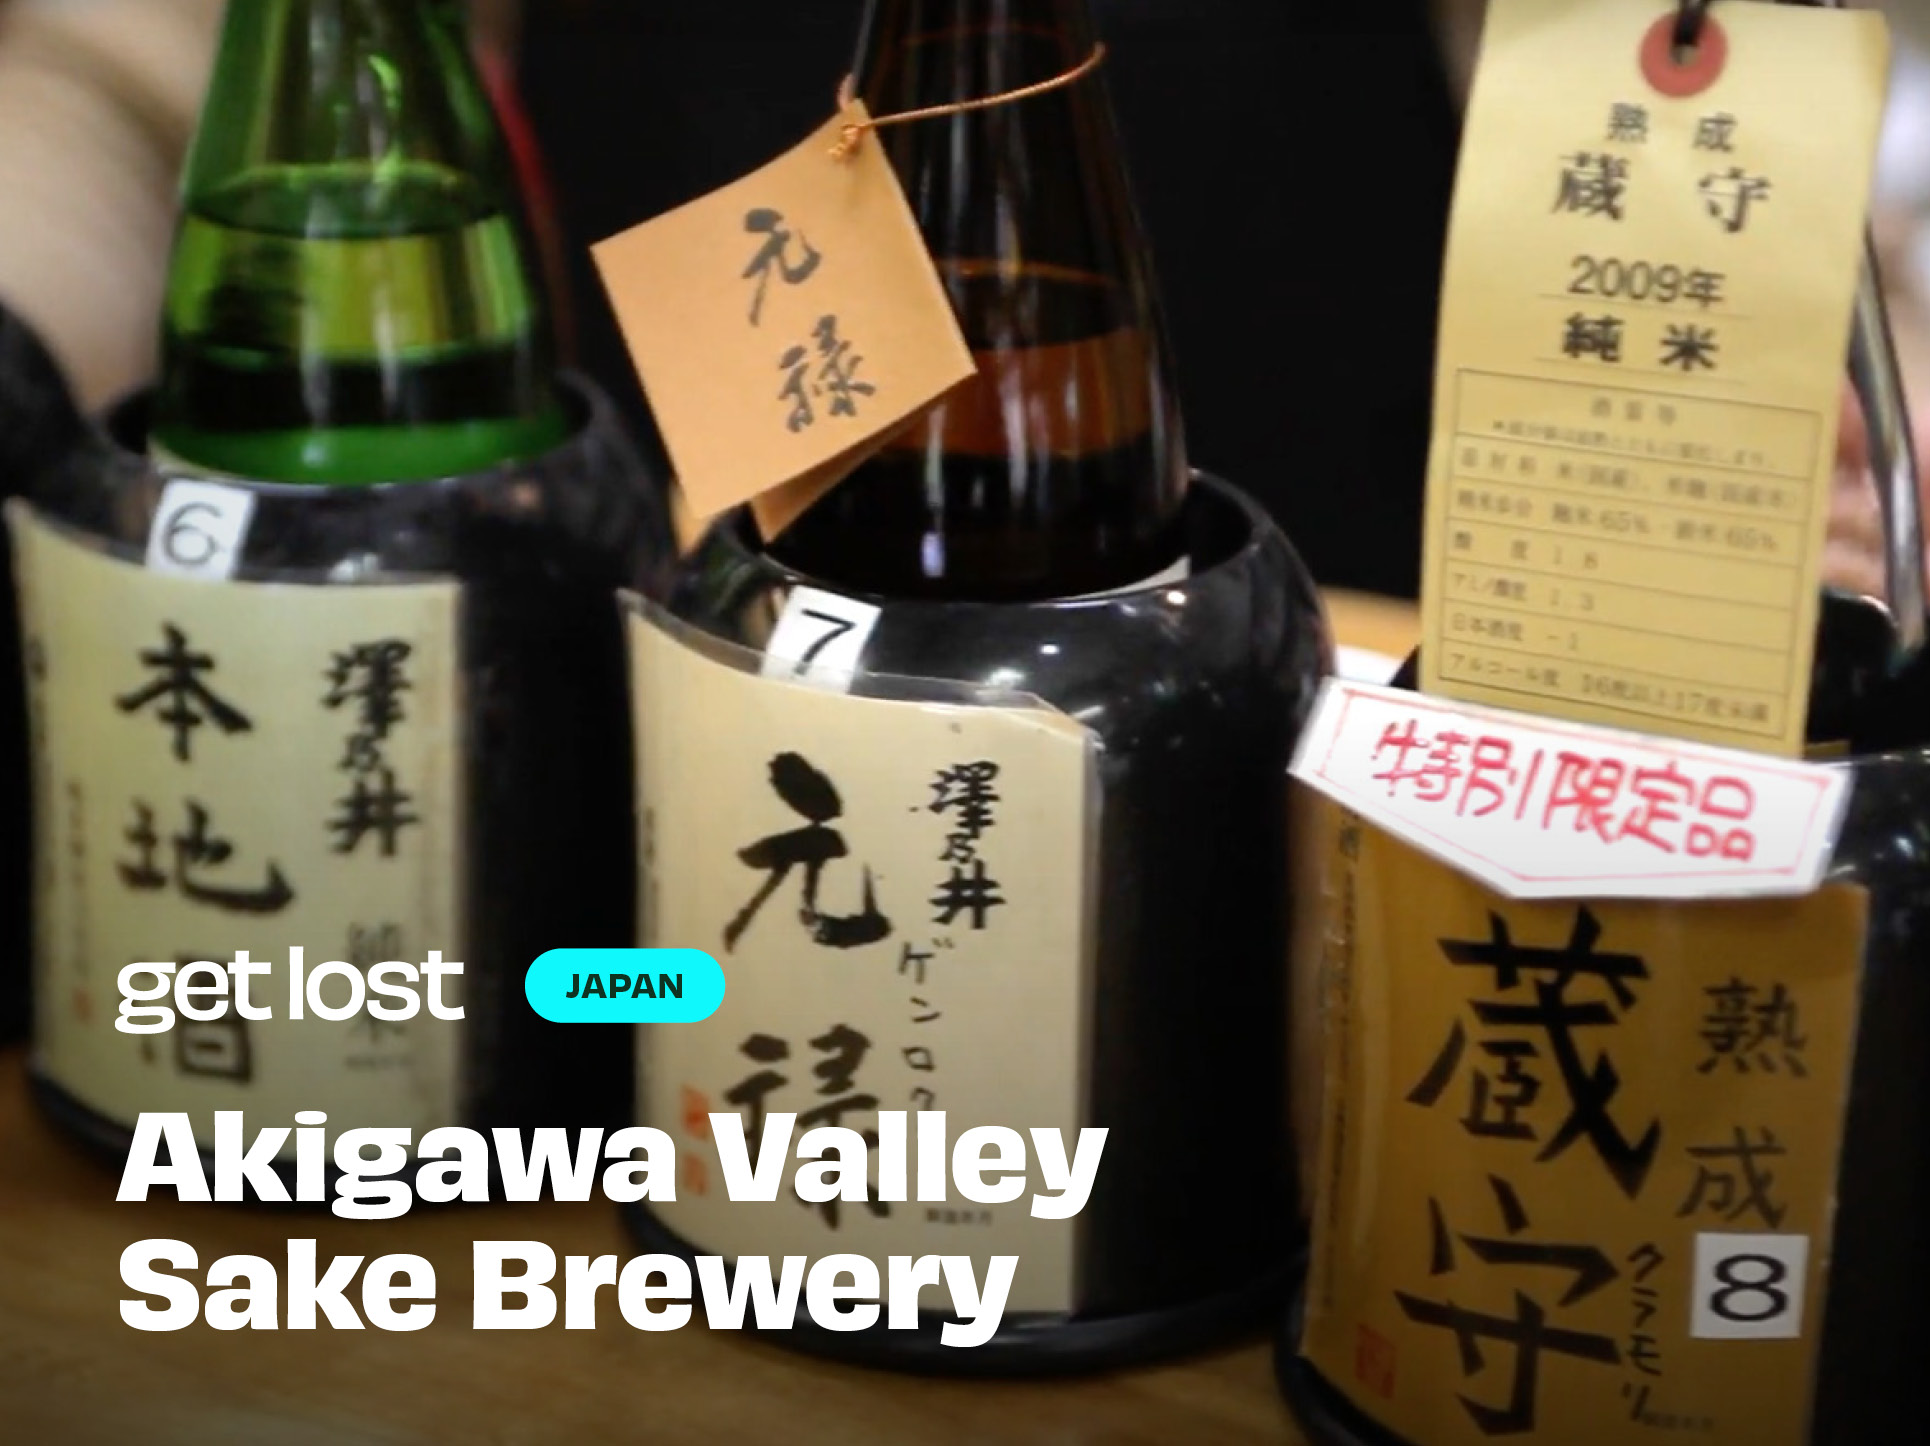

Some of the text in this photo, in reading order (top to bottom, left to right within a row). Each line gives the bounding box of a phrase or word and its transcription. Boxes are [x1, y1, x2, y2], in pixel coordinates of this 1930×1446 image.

[1551, 152, 1771, 234] 蔵守
[1569, 255, 1725, 309] 2009年
[1561, 312, 1720, 371] 純米
[164, 501, 222, 566] 6
[793, 608, 856, 676] 7
[1371, 719, 1756, 862] 特別限定品
[1674, 976, 1810, 1229] 熟成
[1405, 904, 1661, 1437] 蔵守
[1707, 1253, 1790, 1323] 8
